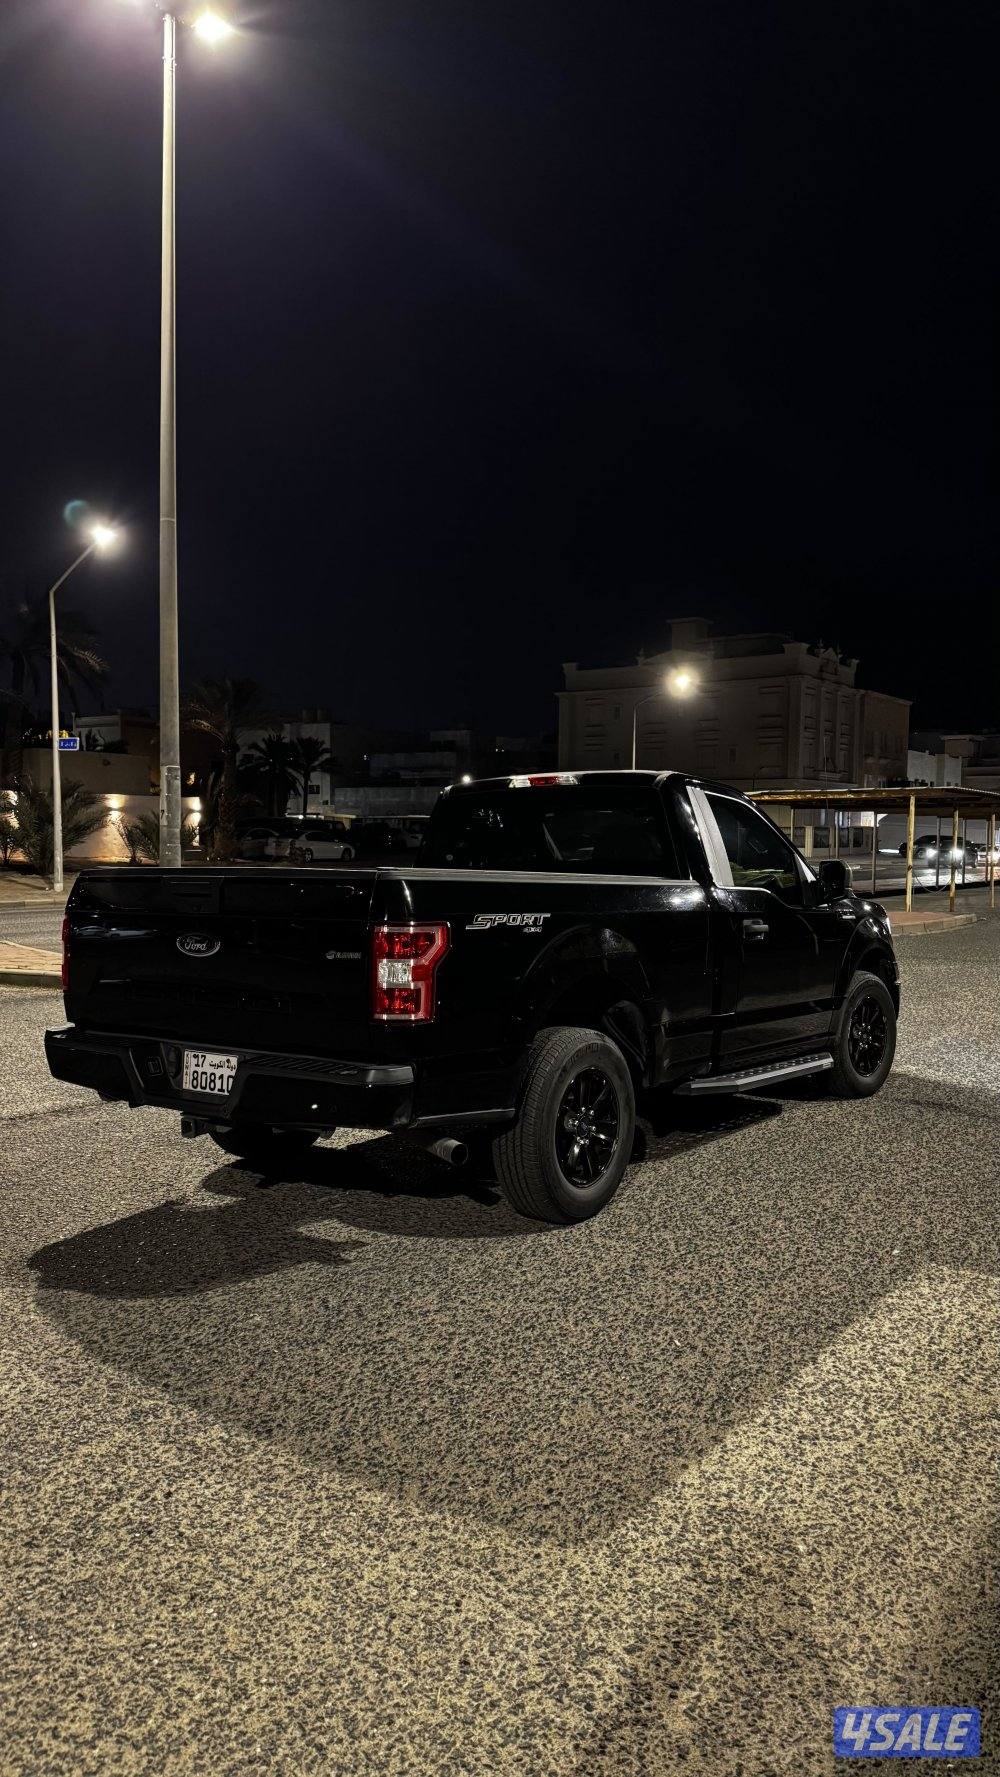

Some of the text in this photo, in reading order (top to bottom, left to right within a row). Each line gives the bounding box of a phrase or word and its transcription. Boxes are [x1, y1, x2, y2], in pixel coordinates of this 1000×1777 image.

[465, 913, 551, 930] SPORT
[184, 936, 208, 951] Ford
[192, 1054, 206, 1068] 17
[191, 1070, 235, 1093] 80810
